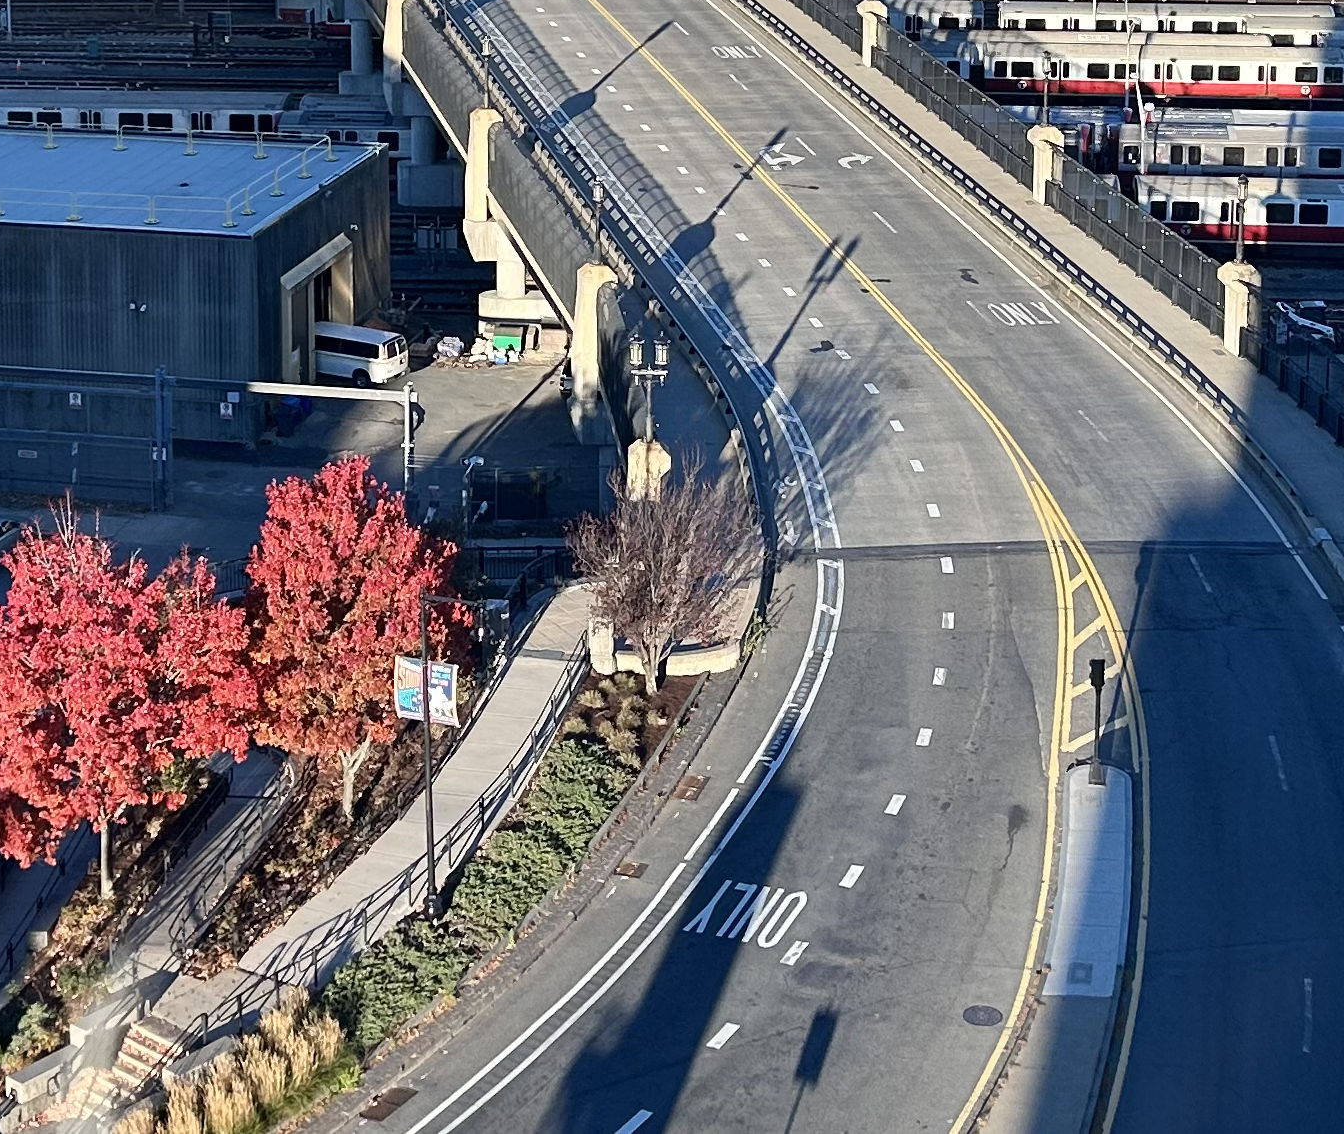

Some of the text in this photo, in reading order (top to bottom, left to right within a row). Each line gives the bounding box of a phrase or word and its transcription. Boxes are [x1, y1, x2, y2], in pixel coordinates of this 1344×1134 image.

[710, 45, 762, 59] ONLY
[987, 302, 1060, 326] ONLY
[682, 880, 808, 948] ONLY
